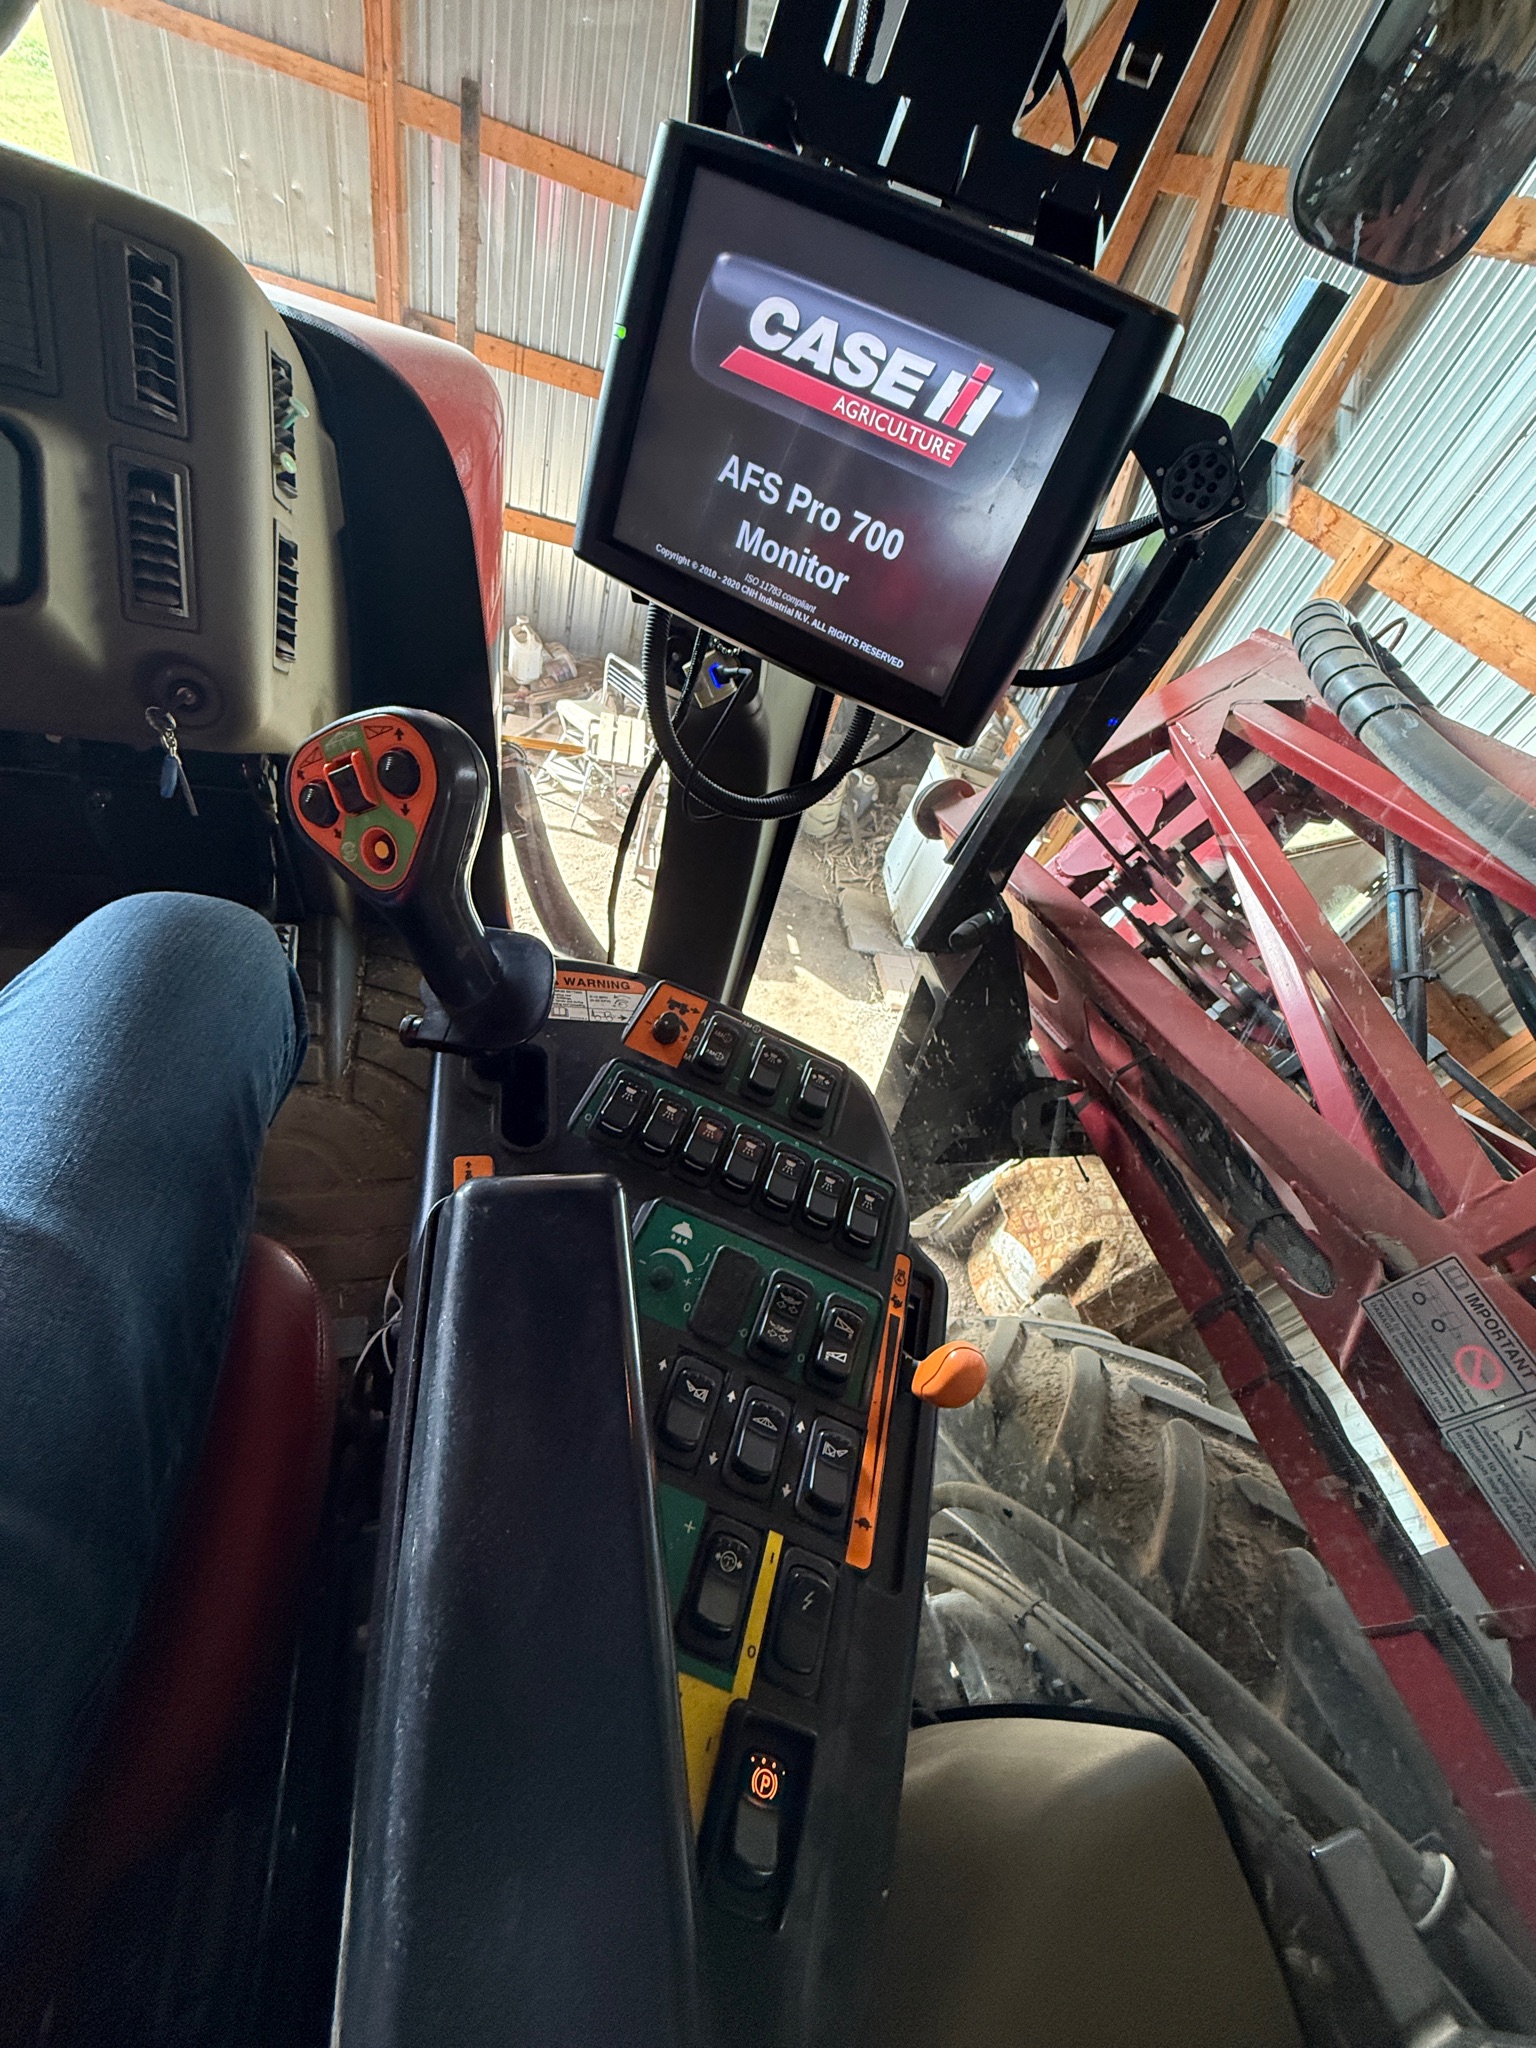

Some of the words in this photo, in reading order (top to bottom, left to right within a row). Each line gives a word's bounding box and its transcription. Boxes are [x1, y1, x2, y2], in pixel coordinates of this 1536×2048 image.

[749, 296, 936, 408] CASE
[832, 395, 956, 463] AGRICULTURE
[718, 454, 782, 505] AFS
[787, 483, 841, 532] Pro
[848, 511, 904, 560] 700
[736, 519, 849, 595] Monitor
[655, 543, 691, 568] Copyright
[699, 564, 718, 581] 2010
[722, 575, 740, 591] 2020
[741, 583, 759, 600] CNH
[758, 592, 795, 617] Industrial
[795, 609, 810, 625] N.V.
[811, 618, 827, 634] ALL
[828, 625, 859, 648] RIGHTS
[859, 641, 905, 670] RESERVED
[744, 573, 759, 586] ISO
[760, 580, 782, 598] 11783
[781, 591, 817, 614] compliant
[563, 976, 631, 990] WARNING
[1368, 1300, 1395, 1334] DAMAGE
[1465, 1292, 1536, 1378] IMPORTANT
[1441, 1396, 1456, 1414] may
